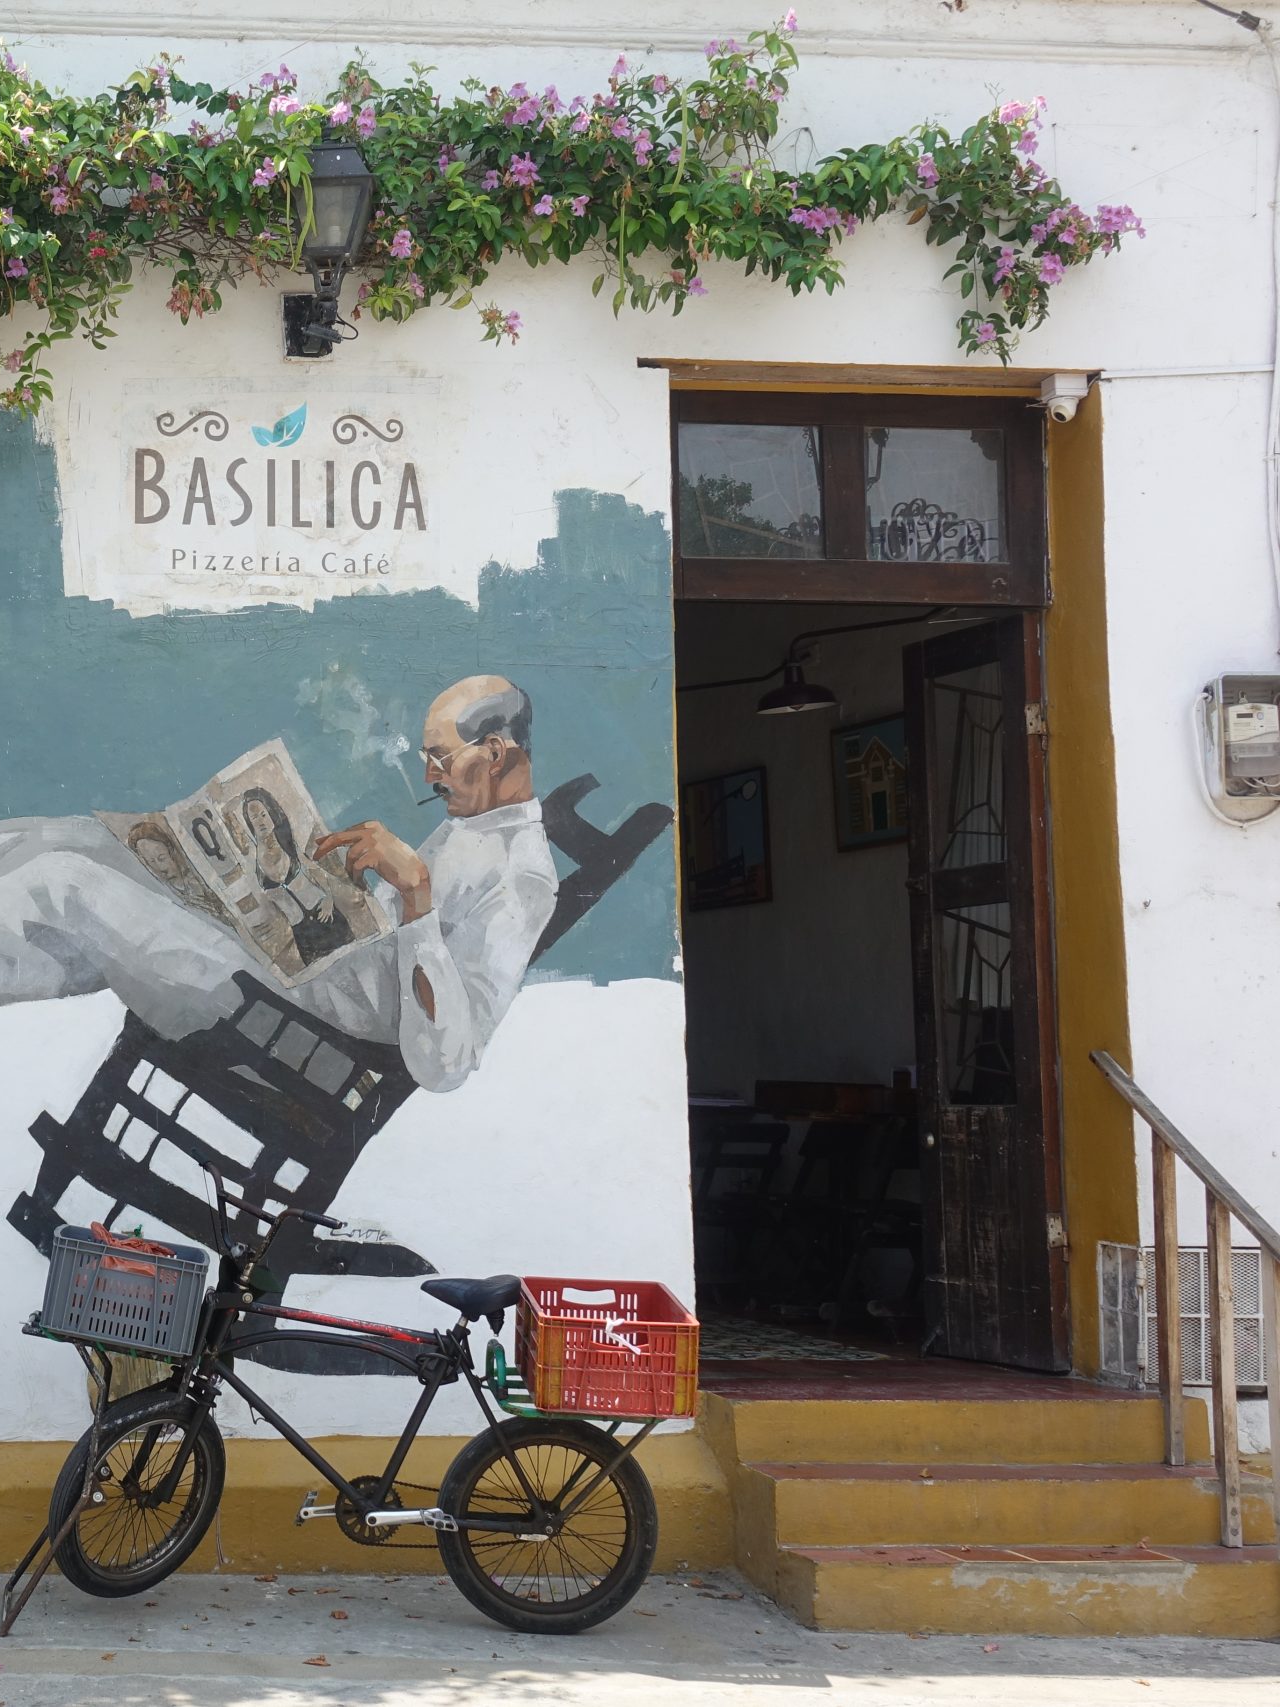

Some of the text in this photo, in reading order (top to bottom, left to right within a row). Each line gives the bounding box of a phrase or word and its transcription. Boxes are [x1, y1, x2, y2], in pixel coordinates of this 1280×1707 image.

[134, 448, 427, 531] BASILICA
[171, 549, 391, 575] Pizzería Café
